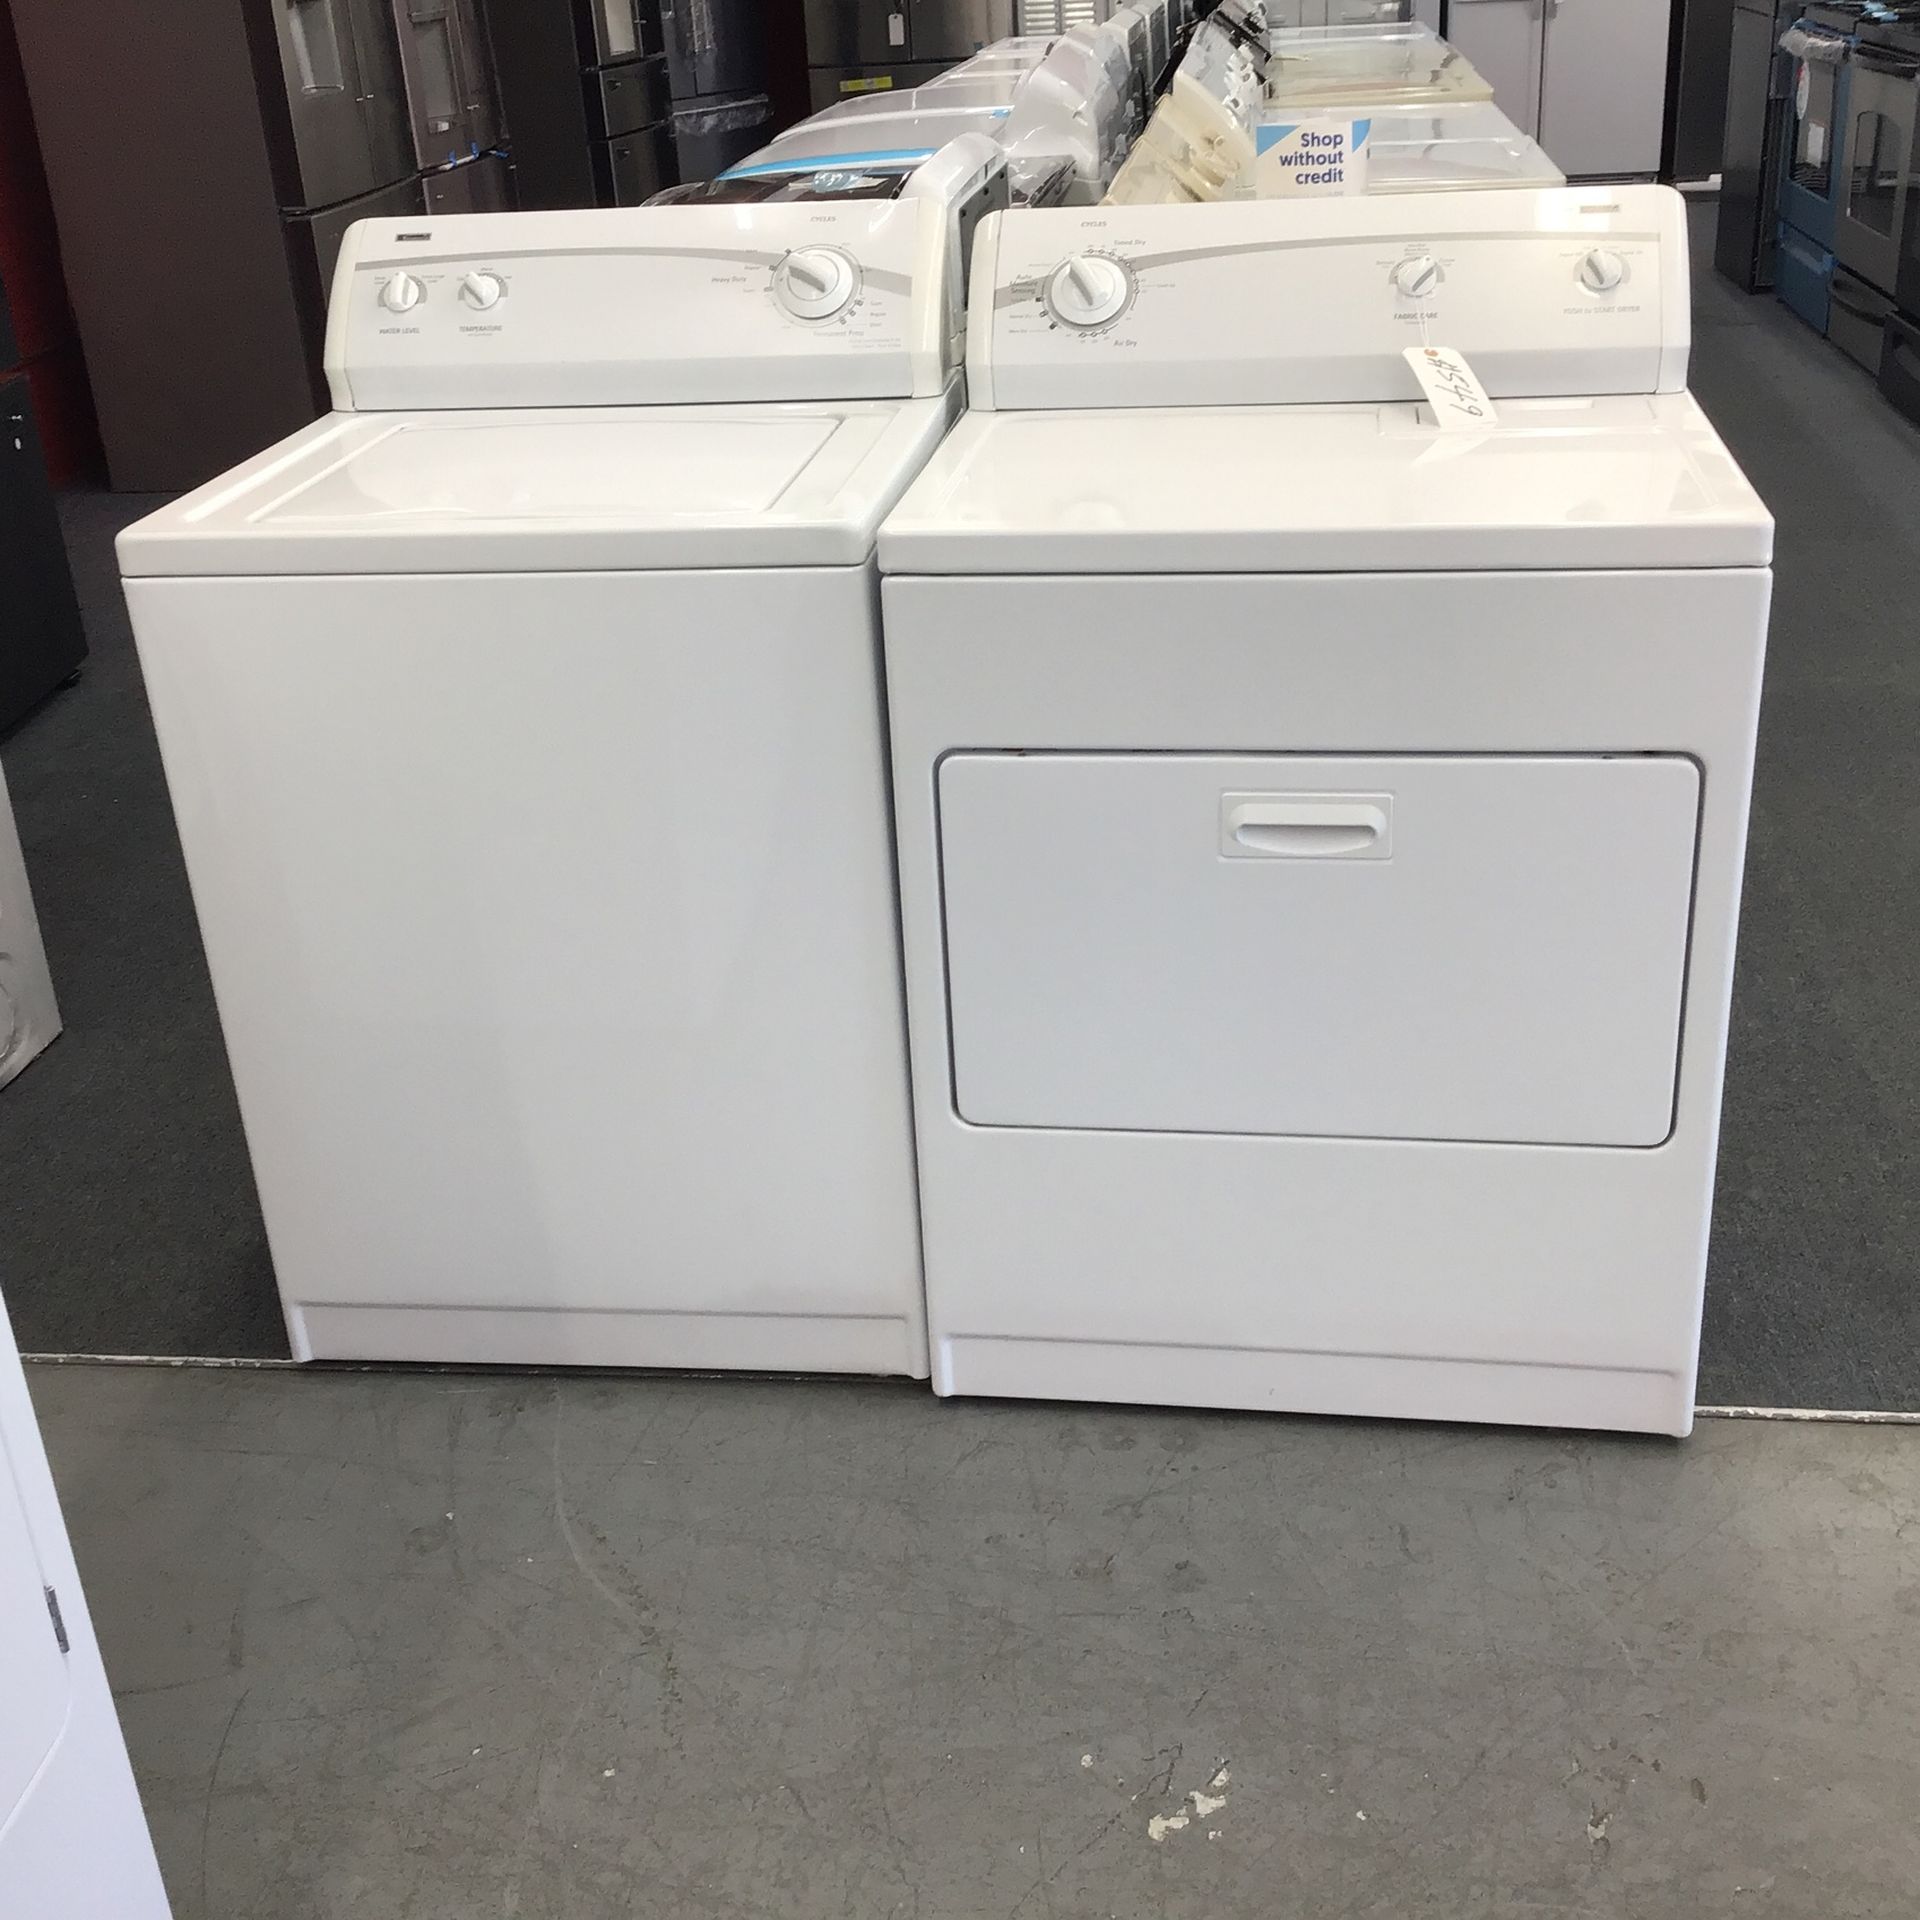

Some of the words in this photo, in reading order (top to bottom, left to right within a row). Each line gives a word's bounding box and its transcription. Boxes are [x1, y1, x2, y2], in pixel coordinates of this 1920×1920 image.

[1301, 132, 1344, 149] Shop
[1279, 150, 1344, 166] without
[1295, 168, 1344, 185] credit
[810, 215, 837, 223] CYCLES
[1080, 220, 1107, 228] CYCLES
[379, 327, 400, 335] WATER
[402, 327, 420, 335] LEVEL
[459, 324, 503, 333] TEMPERATURE
